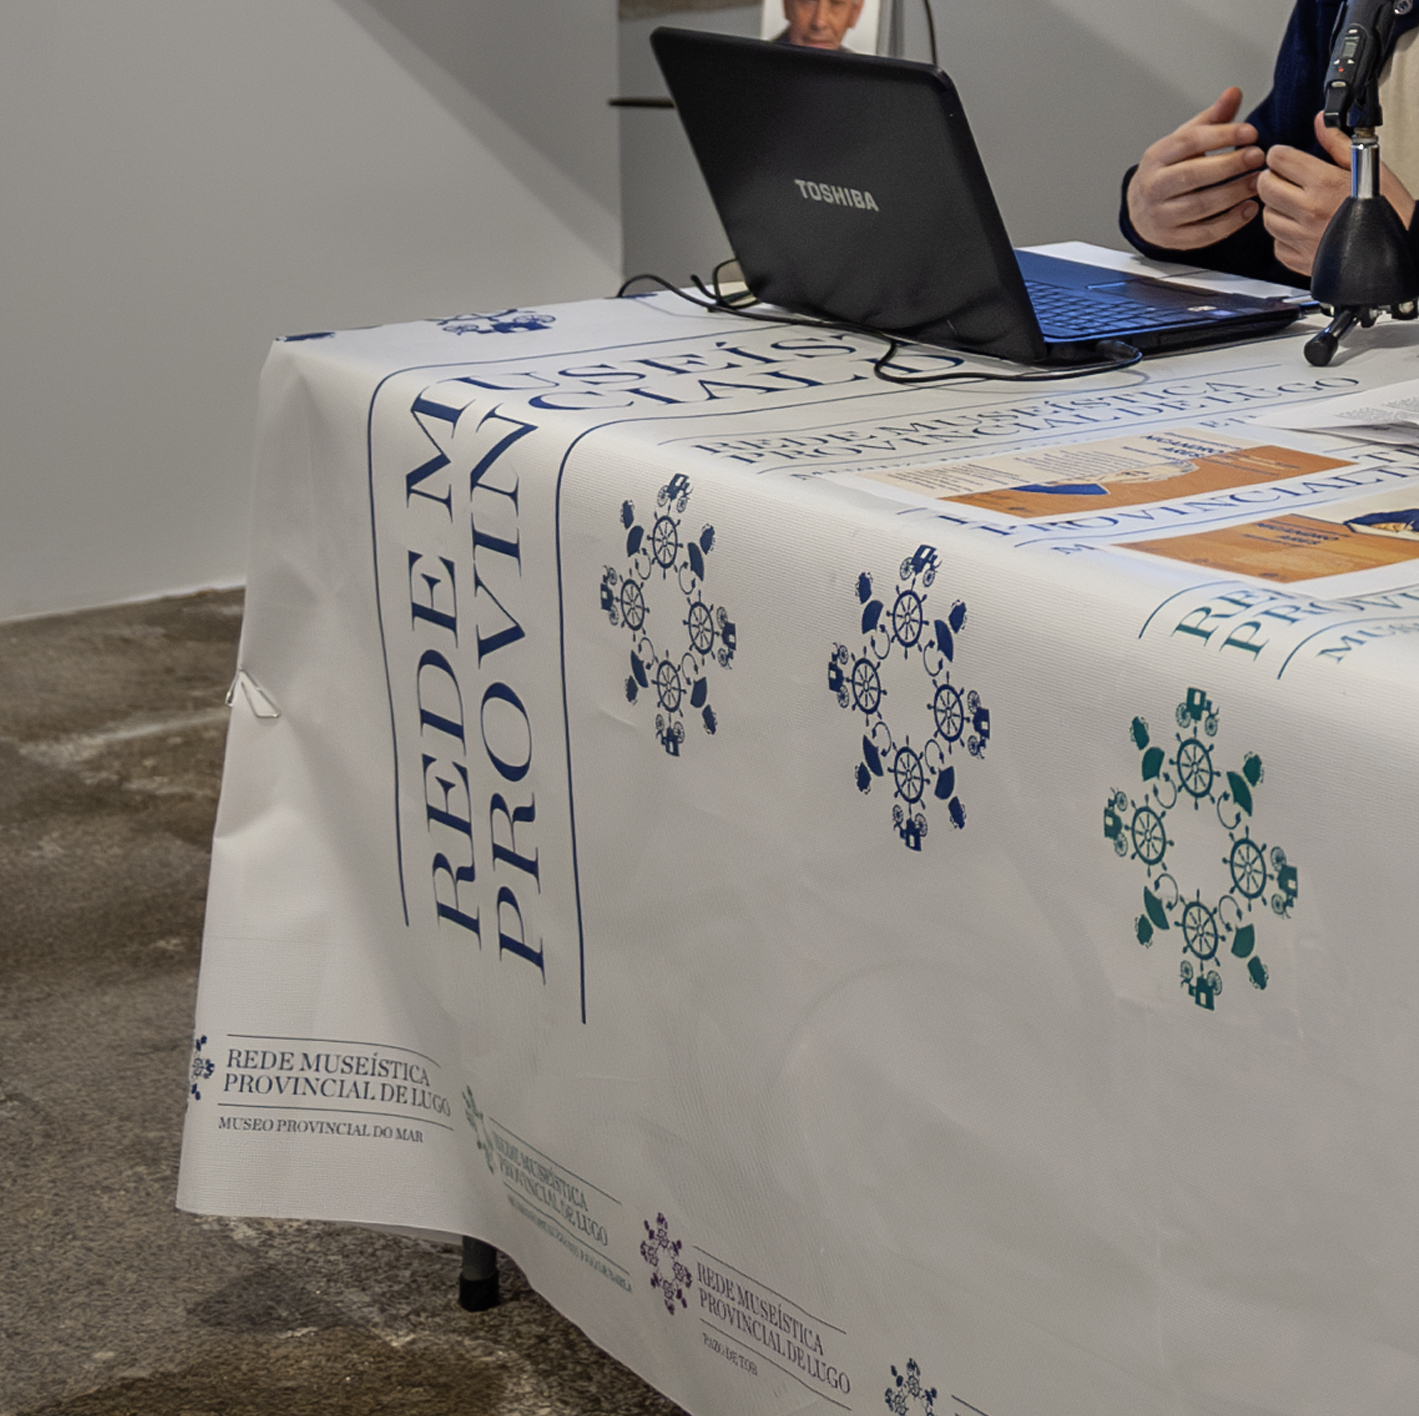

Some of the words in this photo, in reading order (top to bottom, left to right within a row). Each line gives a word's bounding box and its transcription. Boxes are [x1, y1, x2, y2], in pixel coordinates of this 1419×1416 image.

[794, 178, 880, 213] TOSHIBA
[405, 334, 900, 526] MUSEÍS
[691, 430, 877, 457] REDE
[876, 381, 1249, 435] MUSEÍSTICA
[722, 405, 1122, 465] PROVINCIAL
[1116, 399, 1207, 417] DE
[1200, 377, 1361, 406] LUGO
[469, 367, 869, 986] PROVINCIAL
[407, 551, 482, 951] REDE
[222, 1072, 377, 1102] PROVINCIAL
[380, 1084, 408, 1105] DE
[409, 1086, 452, 1118] LUGO
[226, 1047, 295, 1072] REDE
[299, 1051, 431, 1087] MUSEÍSTICA
[218, 1116, 274, 1133] MUSEO
[276, 1118, 371, 1139] PROVINCIAL
[373, 1124, 393, 1140] DO
[395, 1127, 425, 1144] MAR
[696, 1261, 736, 1302] REDE
[737, 1283, 825, 1357] MUSEÍSTICA
[699, 1287, 786, 1357] PROVINCIAL
[786, 1339, 806, 1371] DE
[806, 1353, 852, 1395] LUGO
